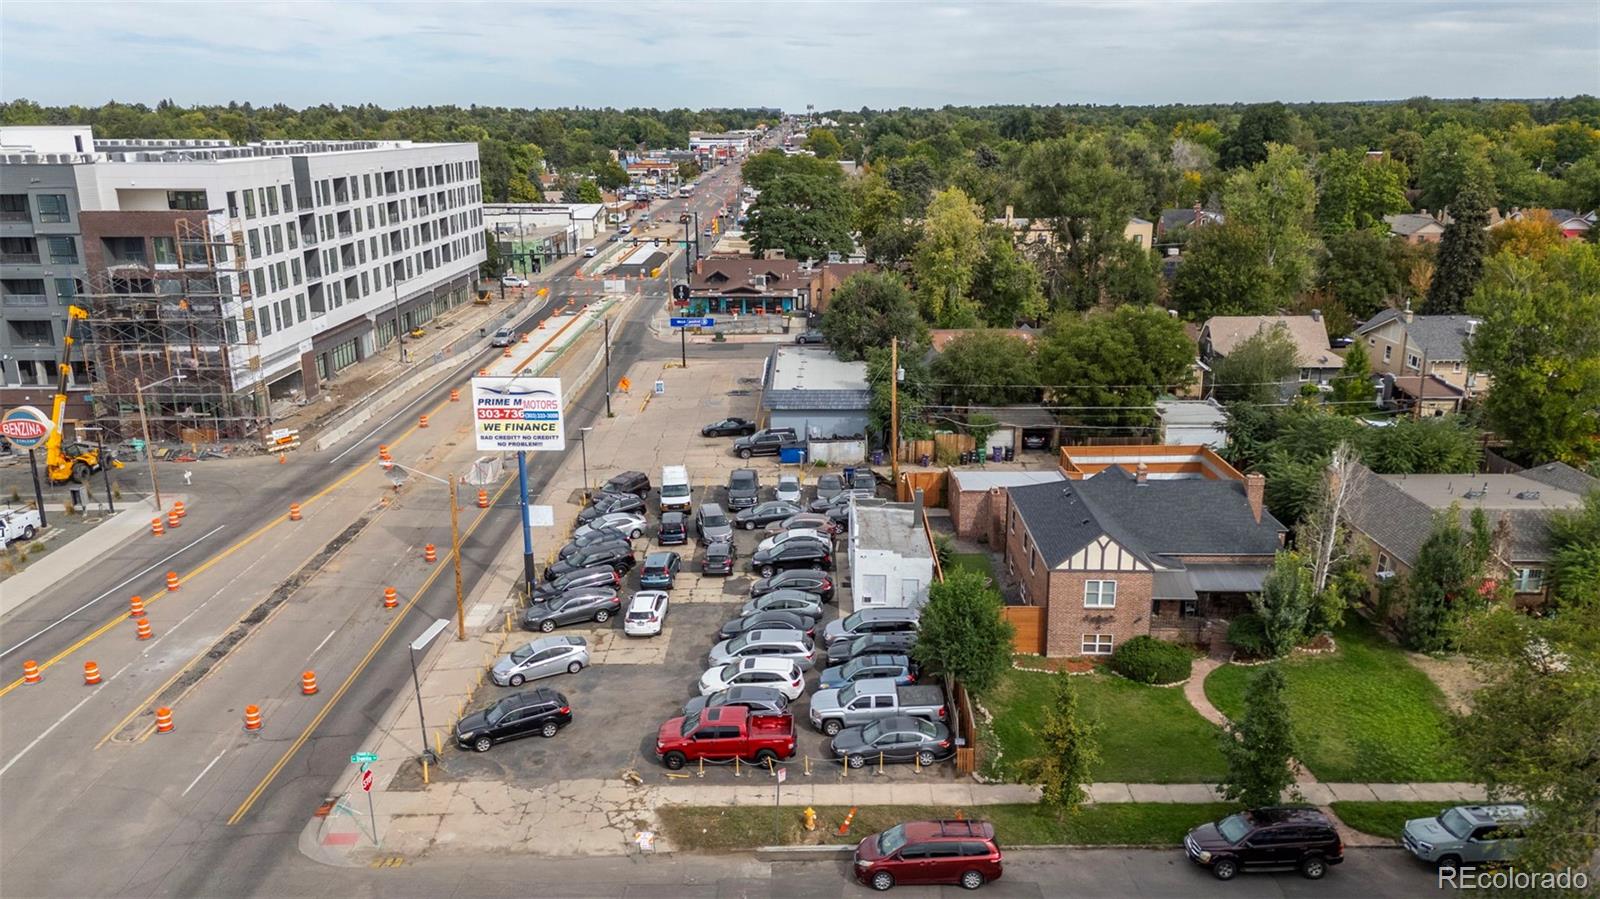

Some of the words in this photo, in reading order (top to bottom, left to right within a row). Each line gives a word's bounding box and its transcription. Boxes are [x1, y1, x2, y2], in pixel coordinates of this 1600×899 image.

[477, 398, 510, 406] PRIME
[513, 398, 522, 406] M
[523, 400, 558, 410] MOTORS
[2, 422, 43, 436] BENZINA
[483, 423, 501, 431] WE
[504, 423, 556, 431] FINANCE
